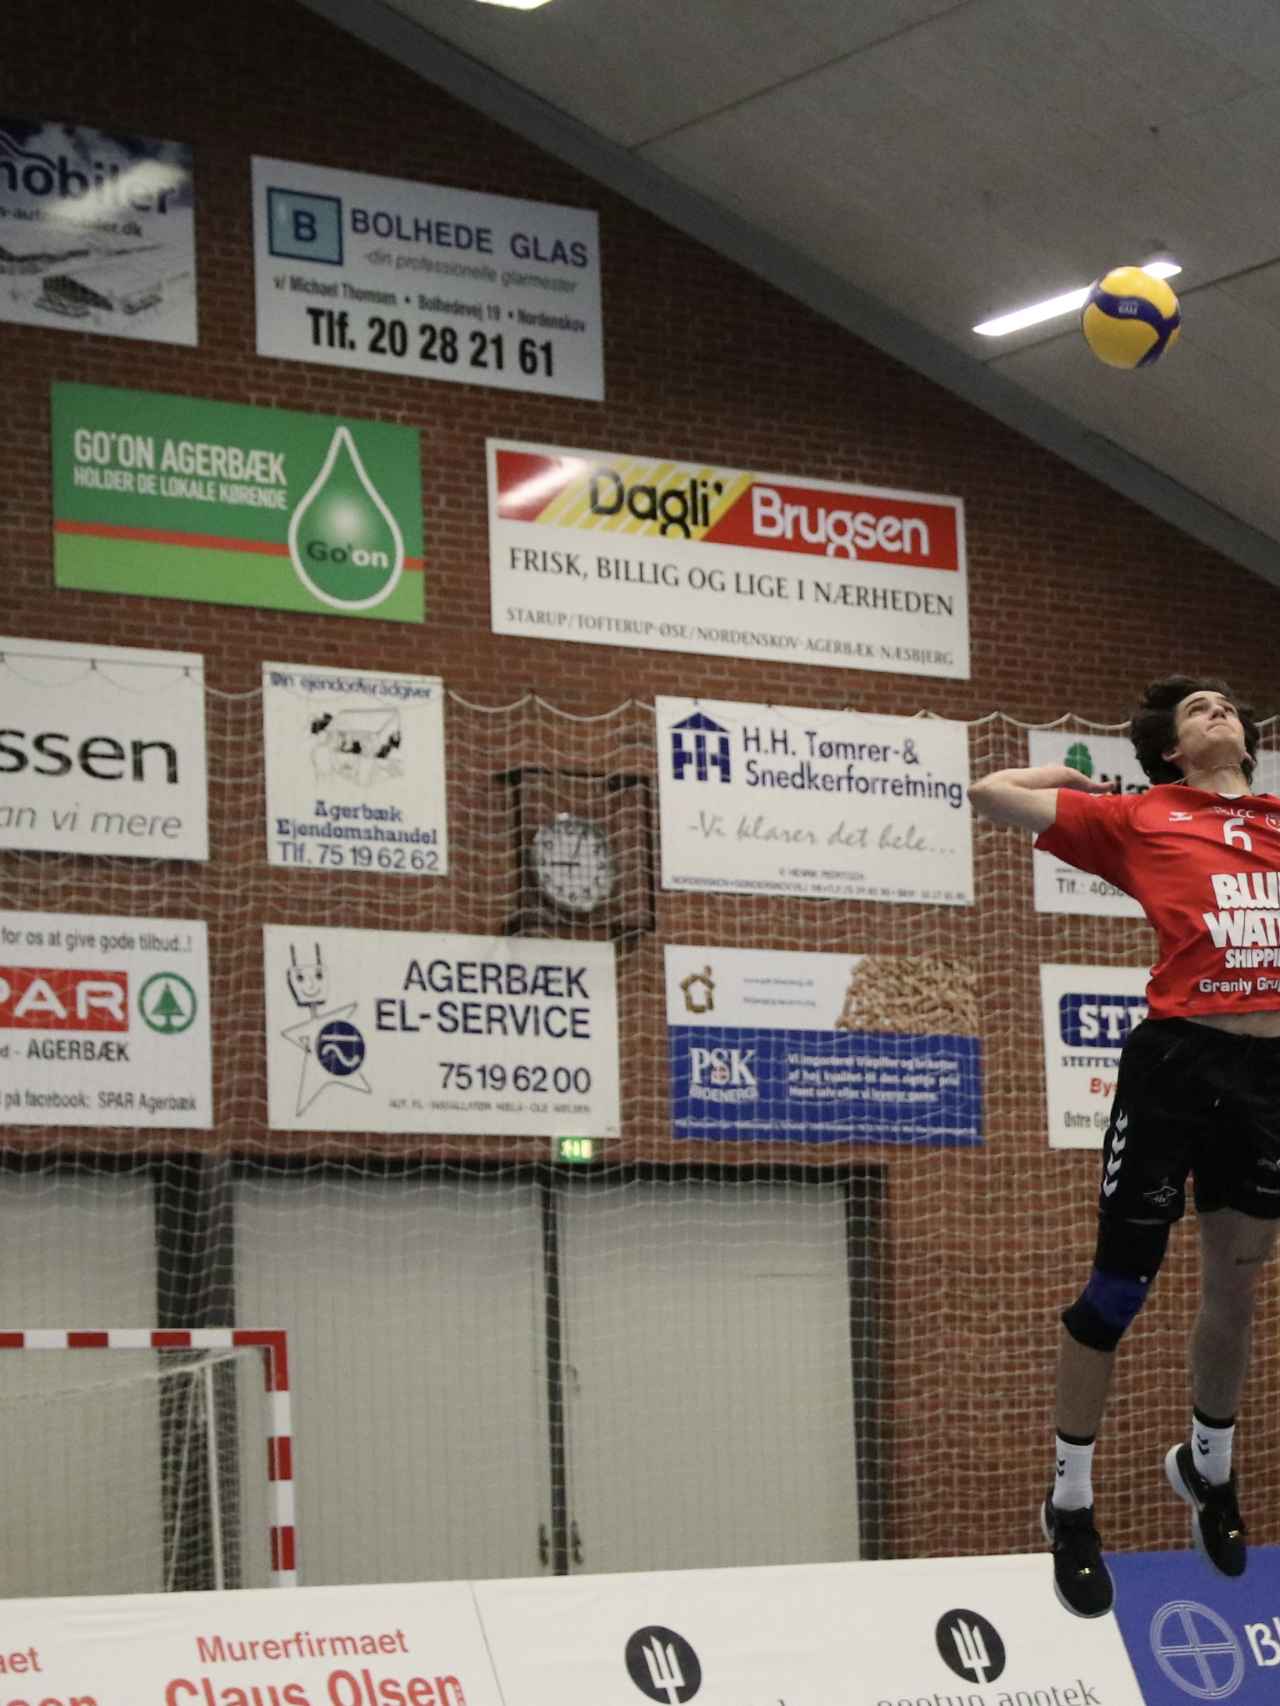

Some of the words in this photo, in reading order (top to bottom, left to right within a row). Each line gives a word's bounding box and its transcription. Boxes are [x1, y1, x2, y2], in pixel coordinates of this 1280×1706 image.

[293, 210, 317, 242] B
[352, 208, 493, 253] BOLHEDE
[510, 233, 588, 267] GLAS
[290, 276, 339, 298] Michael
[342, 282, 398, 305] Thomsen
[517, 308, 586, 333] Nordenskov
[306, 307, 356, 350] Tlf.
[368, 317, 408, 357] 20
[418, 324, 458, 365] 28
[469, 330, 504, 370] 21
[518, 337, 553, 377] 61
[73, 428, 155, 469] GO'ON
[161, 439, 288, 486] AGERBÆK
[73, 465, 133, 492] HOLDER
[137, 472, 157, 496] DE
[160, 475, 215, 502] LOKALE
[752, 486, 930, 560] Brugsen
[509, 546, 589, 582] FRISK,
[596, 556, 680, 587] BILLIG
[688, 566, 726, 593] OG
[734, 572, 789, 600] LIGE
[797, 579, 805, 601] I
[813, 580, 954, 617] NÆRHEDEN
[805, 637, 874, 658] AGERBÆK
[0, 728, 179, 785] ssen
[742, 725, 796, 756] H.H.
[745, 759, 963, 809] Snedkerforretning
[52, 801, 78, 832] vi
[90, 810, 183, 839] mere
[314, 800, 403, 823] Agerbæk
[276, 818, 438, 846] Ejendomshandel
[737, 815, 816, 845] klarer
[827, 820, 869, 848] det
[317, 844, 344, 866] 75
[65, 932, 95, 953] give
[99, 934, 135, 954] gode
[403, 959, 590, 999] AGERBÆK
[1199, 977, 1252, 995] Granly
[0, 977, 126, 1021] AR
[375, 998, 591, 1039] EL-SERVICE
[27, 1038, 130, 1062] AGERBÆK
[688, 1047, 758, 1086] PSK
[438, 1063, 472, 1090] 75
[476, 1064, 507, 1091] 19
[512, 1065, 548, 1092] 62
[553, 1066, 592, 1094] 00
[1090, 1077, 1118, 1097] By
[98, 1091, 134, 1111] SPAR
[138, 1092, 197, 1115] Agerbæk
[196, 1630, 409, 1663] Murerfirmaet
[165, 1677, 310, 1706] Claus
[327, 1668, 467, 1706] Olsen
